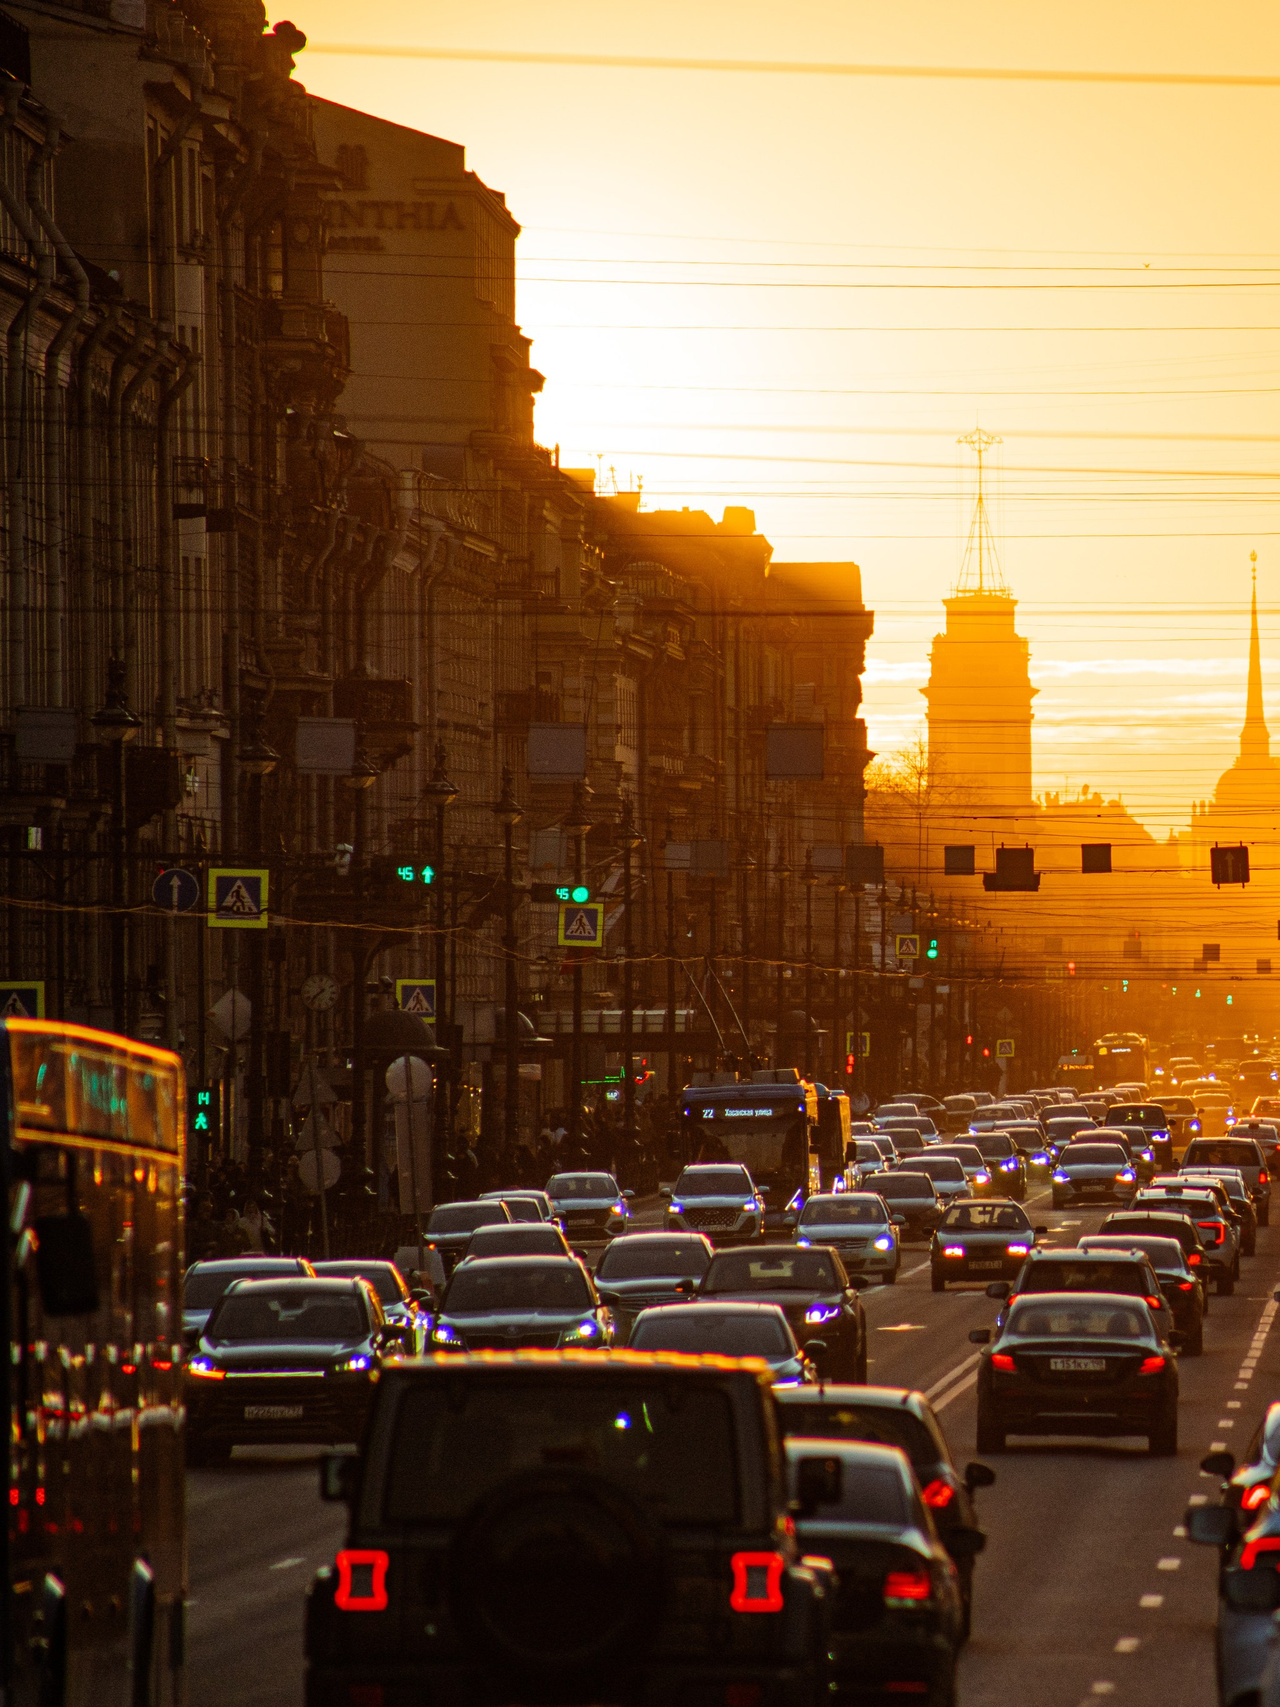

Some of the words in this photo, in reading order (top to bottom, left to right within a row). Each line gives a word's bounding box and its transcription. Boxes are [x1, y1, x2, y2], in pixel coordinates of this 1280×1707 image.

[397, 866, 415, 881] 45
[556, 887, 570, 900] 45
[702, 1108, 714, 1119] 22
